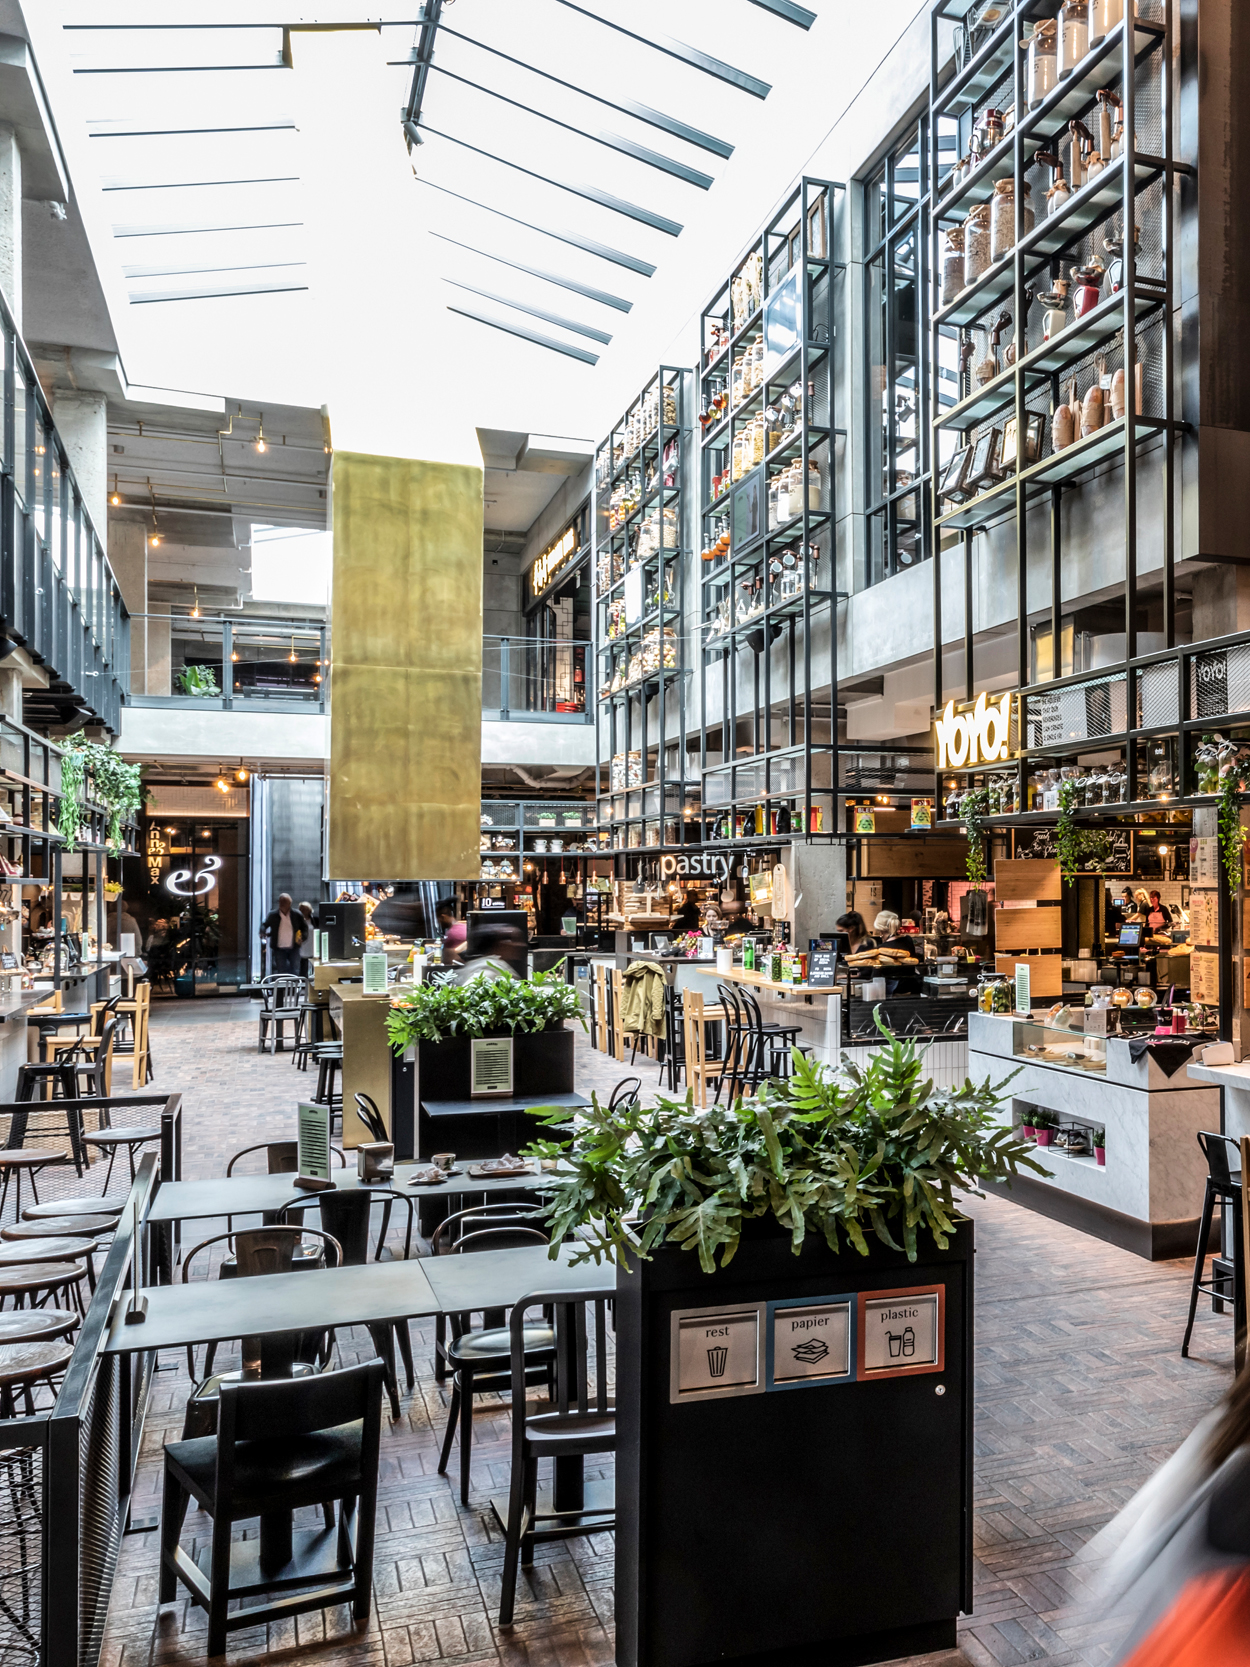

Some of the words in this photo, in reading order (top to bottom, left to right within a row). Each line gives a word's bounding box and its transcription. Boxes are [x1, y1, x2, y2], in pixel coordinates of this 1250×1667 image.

[935, 687, 1010, 768] YOYO!
[661, 850, 735, 881] pastry
[880, 1308, 919, 1323] plastic
[705, 1326, 730, 1338] rest
[791, 1316, 830, 1332] papier
